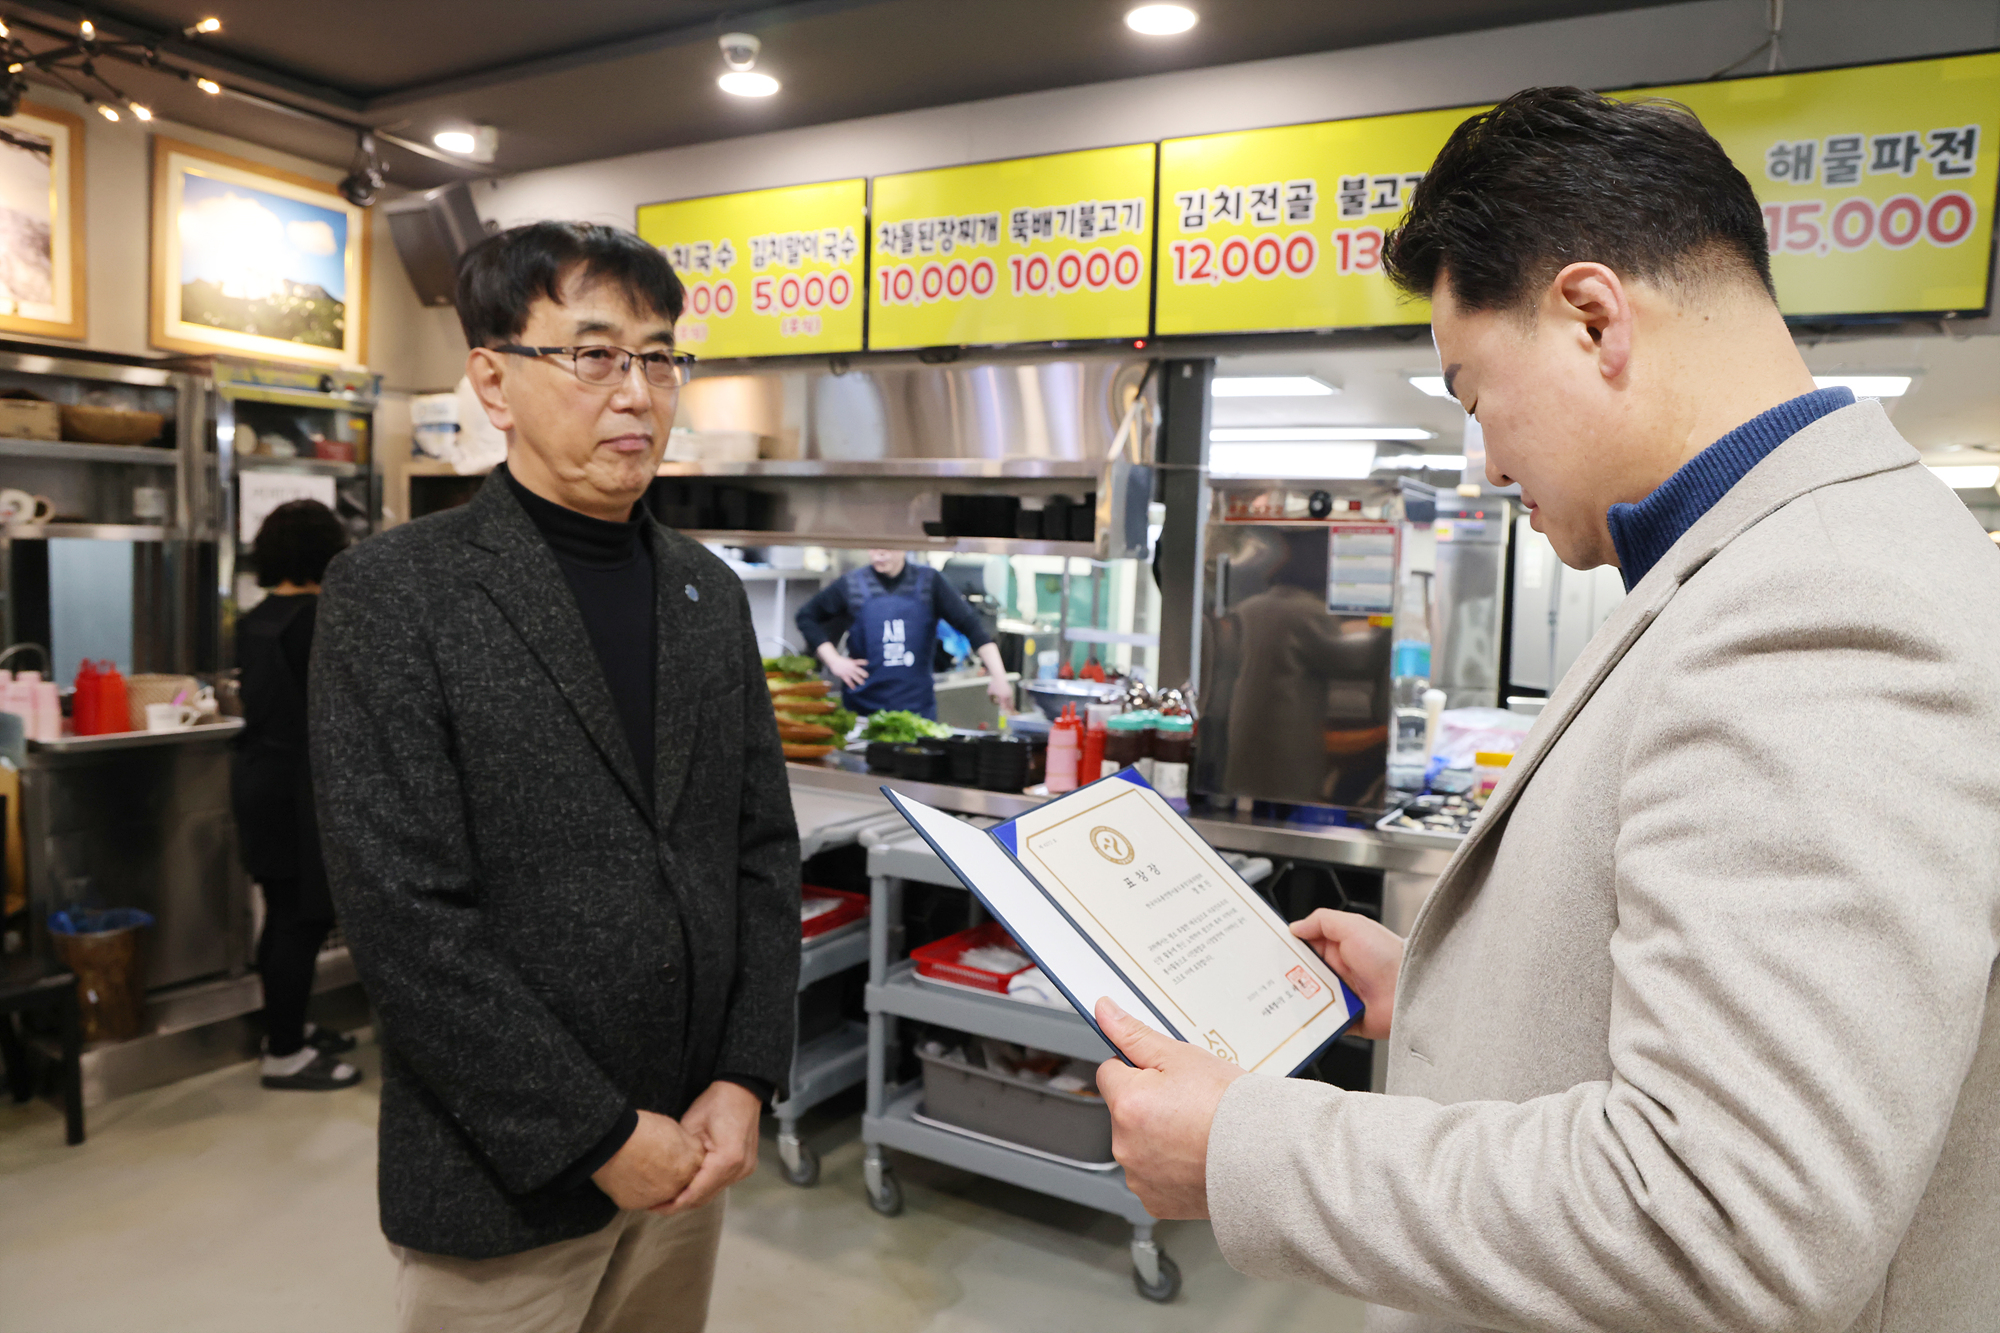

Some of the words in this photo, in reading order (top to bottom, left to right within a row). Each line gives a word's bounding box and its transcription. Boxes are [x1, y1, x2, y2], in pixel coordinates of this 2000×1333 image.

[1769, 129, 1977, 184] 해물파전
[880, 215, 998, 253] 차돌된장찌개
[1012, 203, 1141, 244] 뚝배기불고기
[1180, 183, 1313, 227] 김치전골
[1764, 194, 1972, 252] 15,000
[660, 242, 734, 270] 치국수
[881, 261, 994, 302] 10,000
[1012, 250, 1139, 292] 10,000
[1174, 236, 1313, 281] 12,000
[1337, 231, 1382, 270] 13
[683, 284, 734, 315] 00
[756, 274, 849, 312] 5,000
